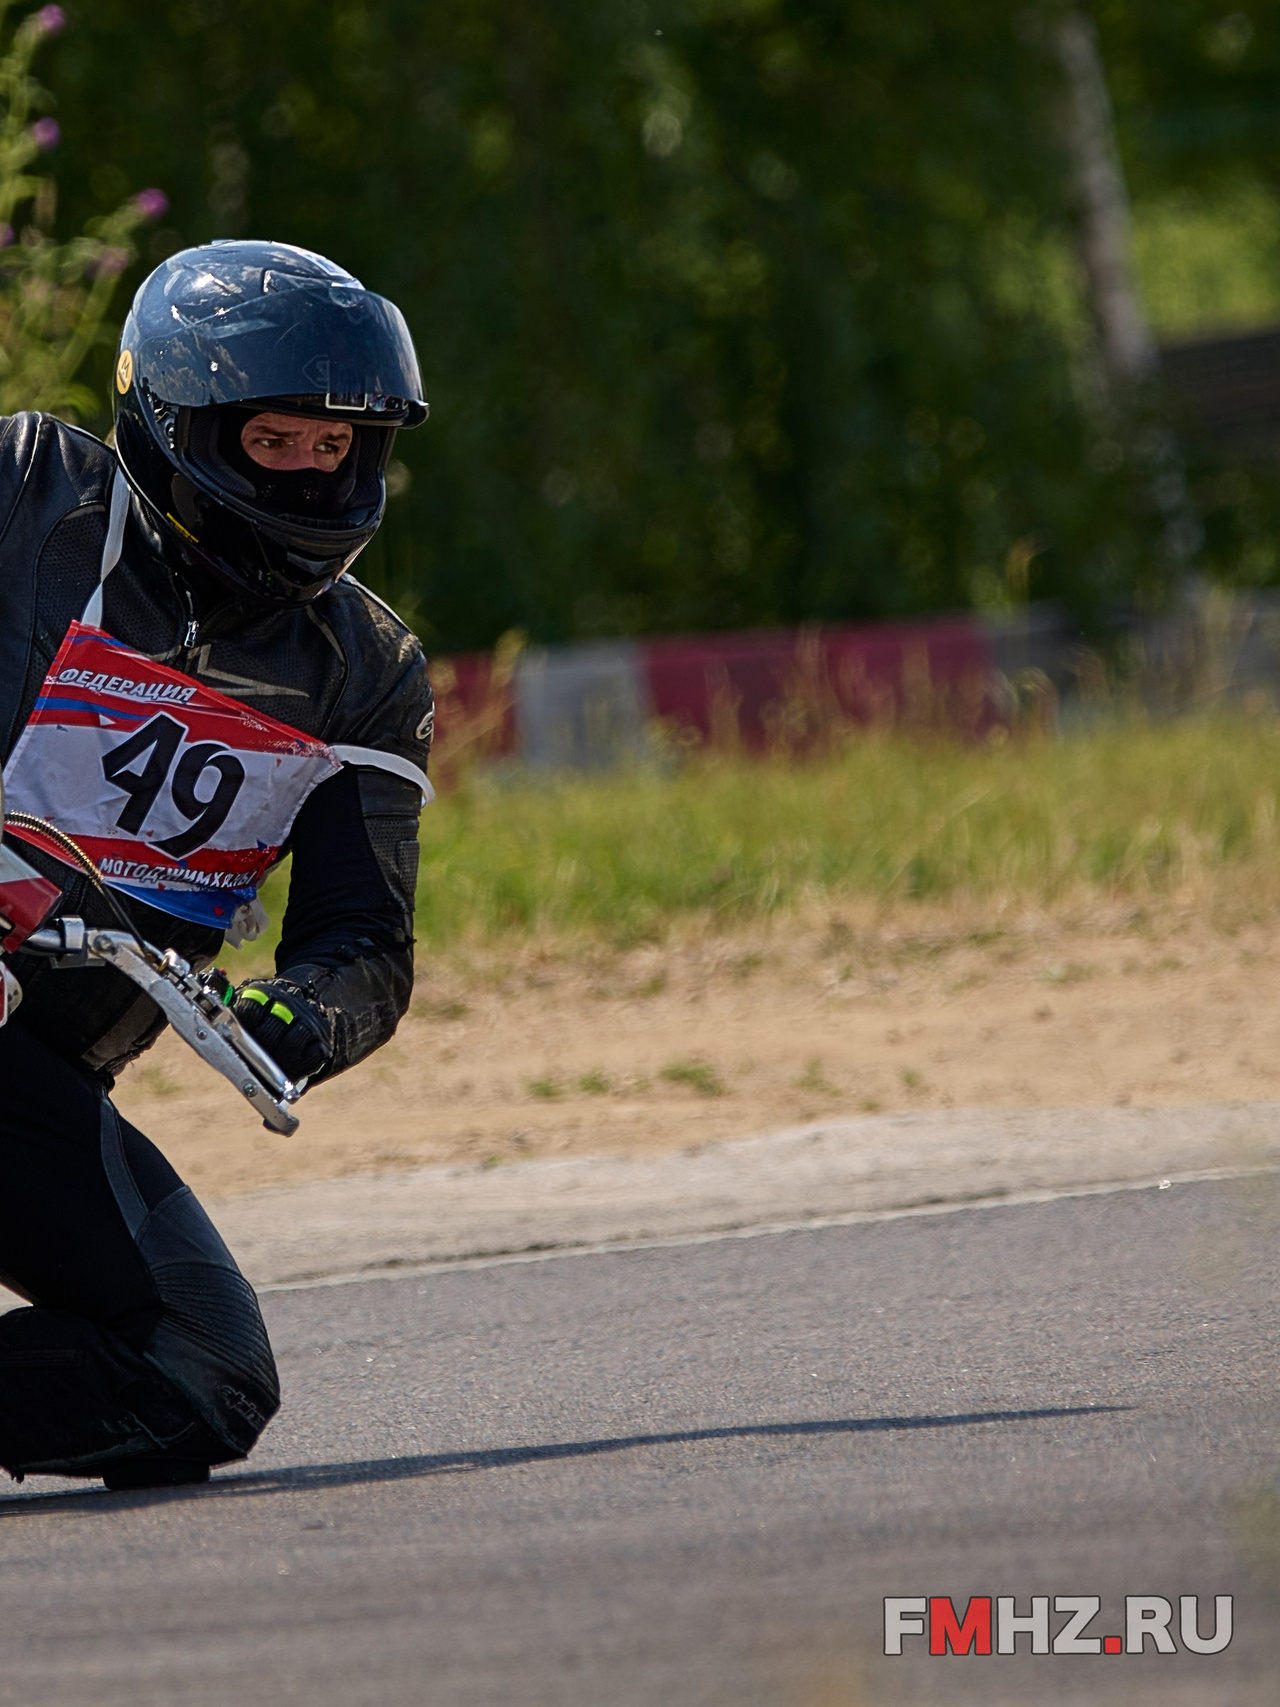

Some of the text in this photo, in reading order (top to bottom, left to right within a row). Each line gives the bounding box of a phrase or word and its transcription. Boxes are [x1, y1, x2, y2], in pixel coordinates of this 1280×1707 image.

[58, 668, 198, 702] ФЕДЕРАЦИЯ
[101, 711, 246, 860] 49
[99, 857, 258, 889] МОТОДЖИМХАНЫ
